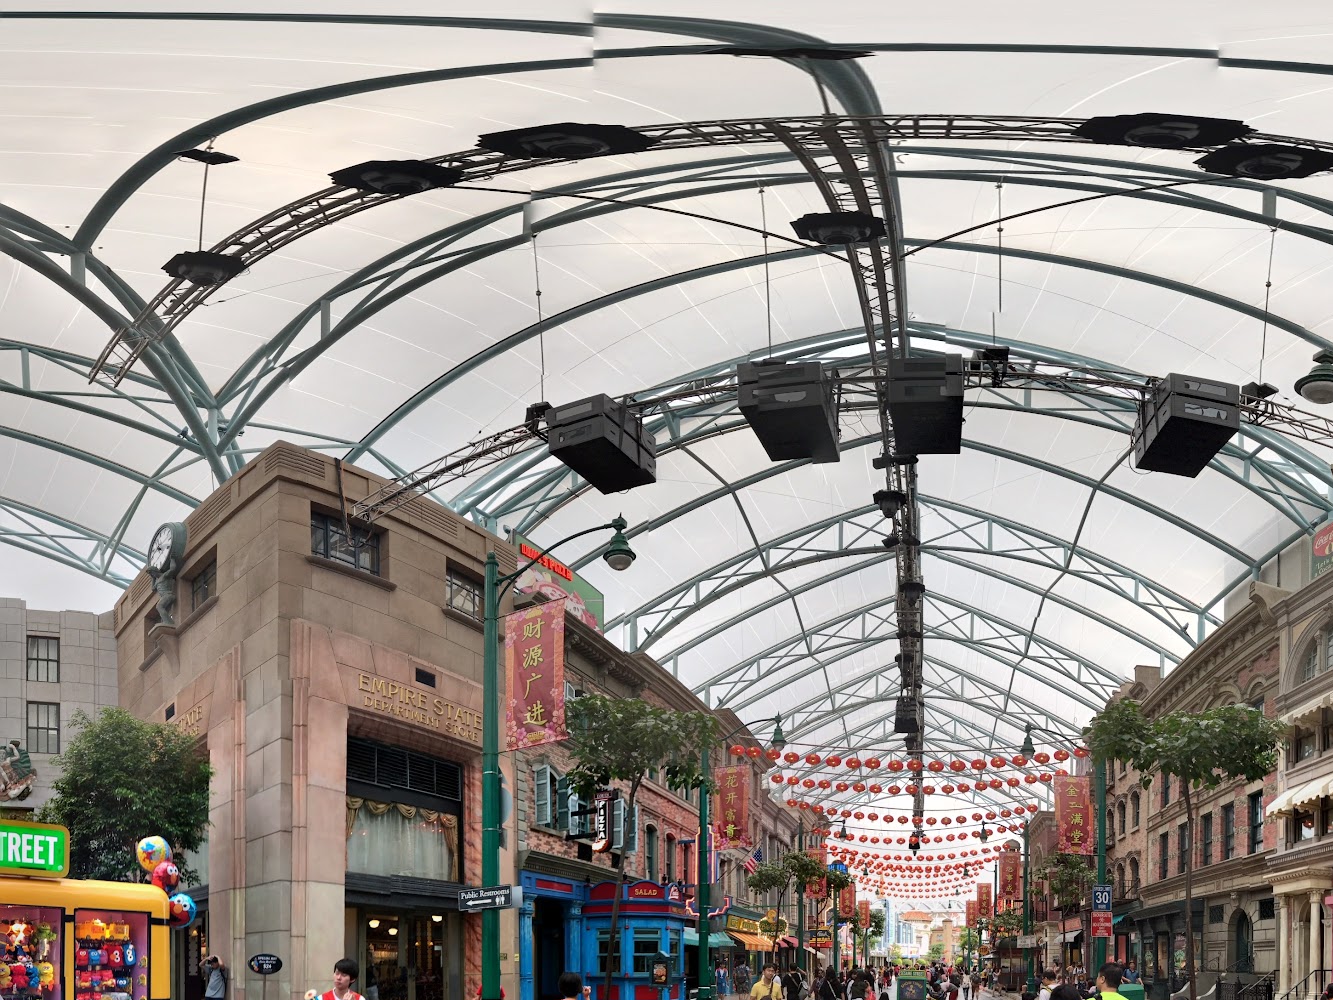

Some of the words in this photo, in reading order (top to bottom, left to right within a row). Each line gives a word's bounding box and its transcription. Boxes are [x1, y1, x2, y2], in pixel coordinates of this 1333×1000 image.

[521, 617, 548, 727] 财源广进
[358, 673, 428, 711] EMPIRE
[433, 698, 482, 731] STATE
[364, 695, 440, 729] DEPARTMENT
[445, 721, 478, 743] STORE
[598, 800, 606, 839] PIZZA
[480, 889, 510, 897] Restrooms
[1096, 892, 1109, 903] 30
